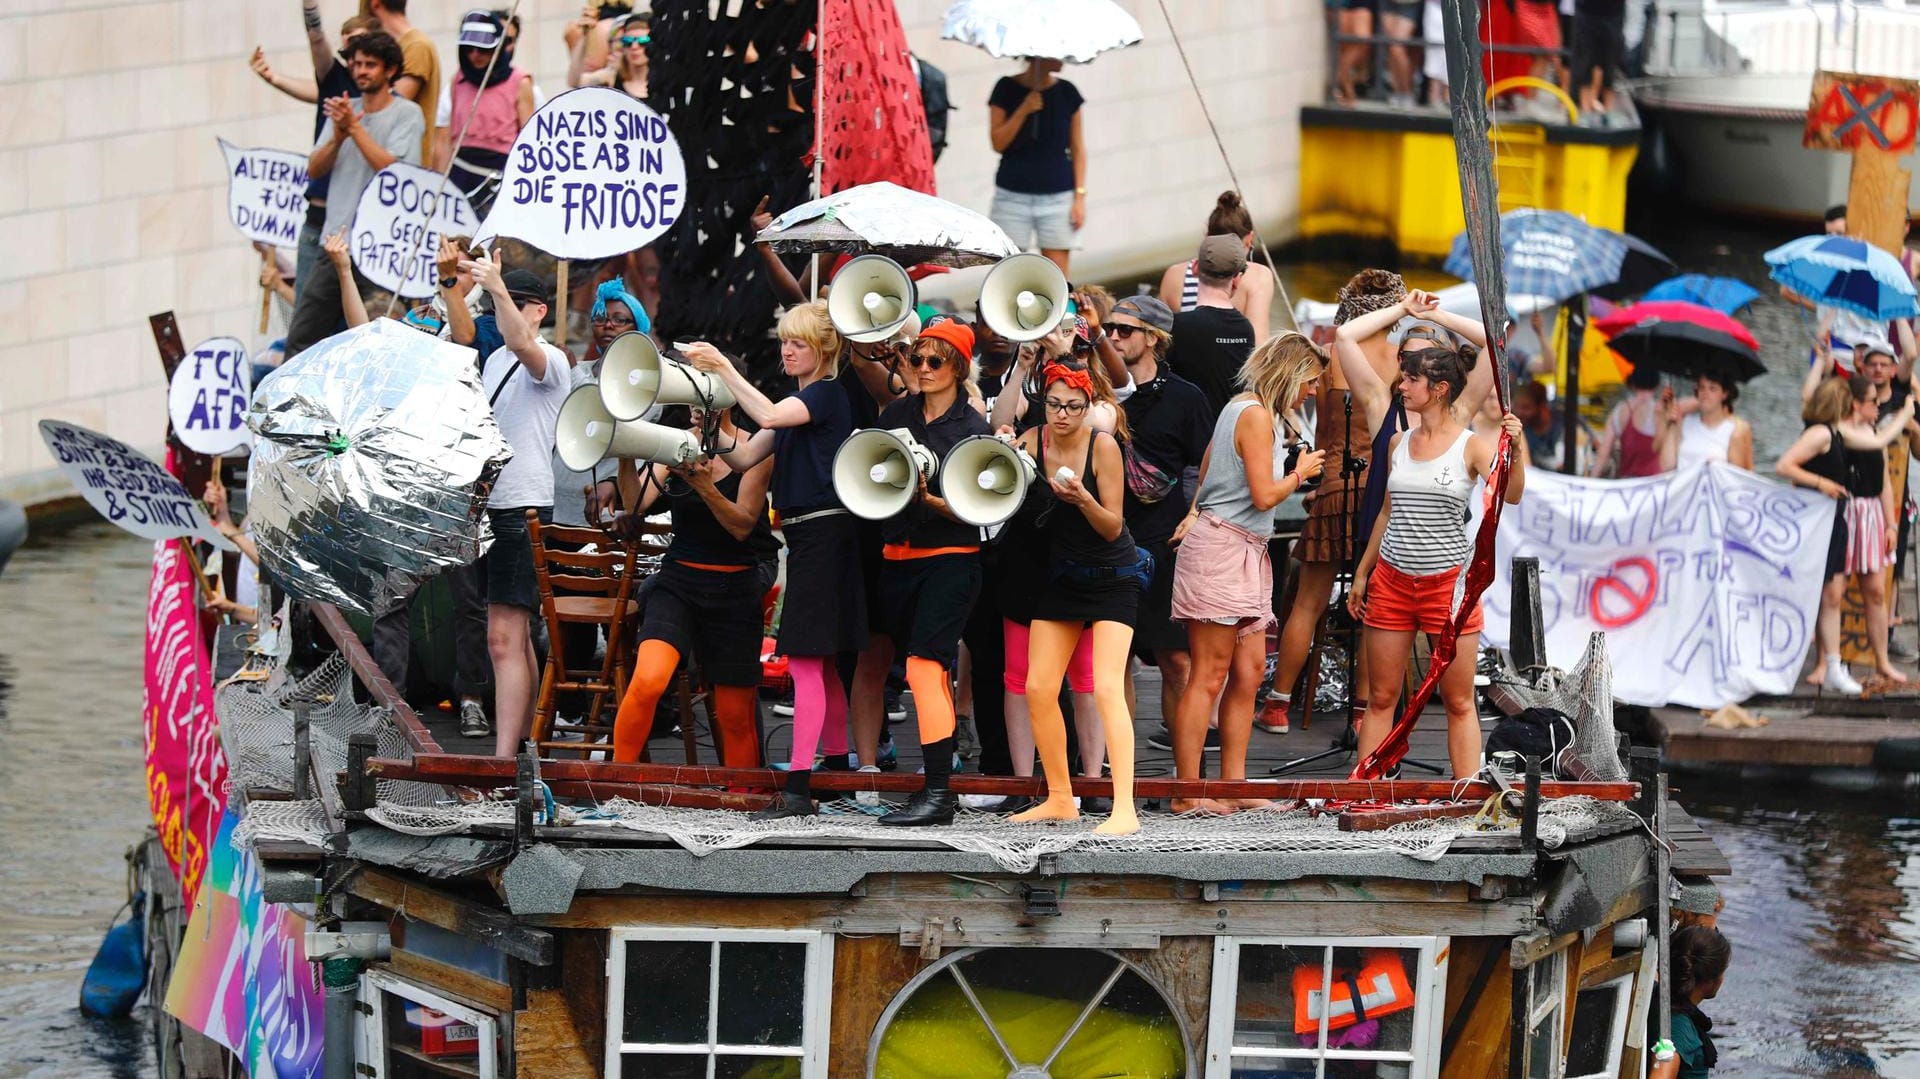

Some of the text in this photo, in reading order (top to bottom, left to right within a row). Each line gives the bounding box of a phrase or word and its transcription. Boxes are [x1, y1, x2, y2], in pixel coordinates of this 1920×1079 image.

[536, 110, 667, 144] NAZIS SIND
[517, 140, 662, 174] BÖSE AB IN
[260, 184, 302, 212] FÜR
[378, 171, 464, 226] BOOTE
[513, 175, 678, 235] DIE FRITÖSE
[237, 205, 295, 240] DUMM
[193, 350, 244, 392] FCK
[185, 388, 247, 430] AFD
[52, 441, 101, 465] BUNT
[82, 467, 116, 489] IHR
[105, 490, 198, 529] & STINKT
[1664, 587, 1807, 684] AFD
